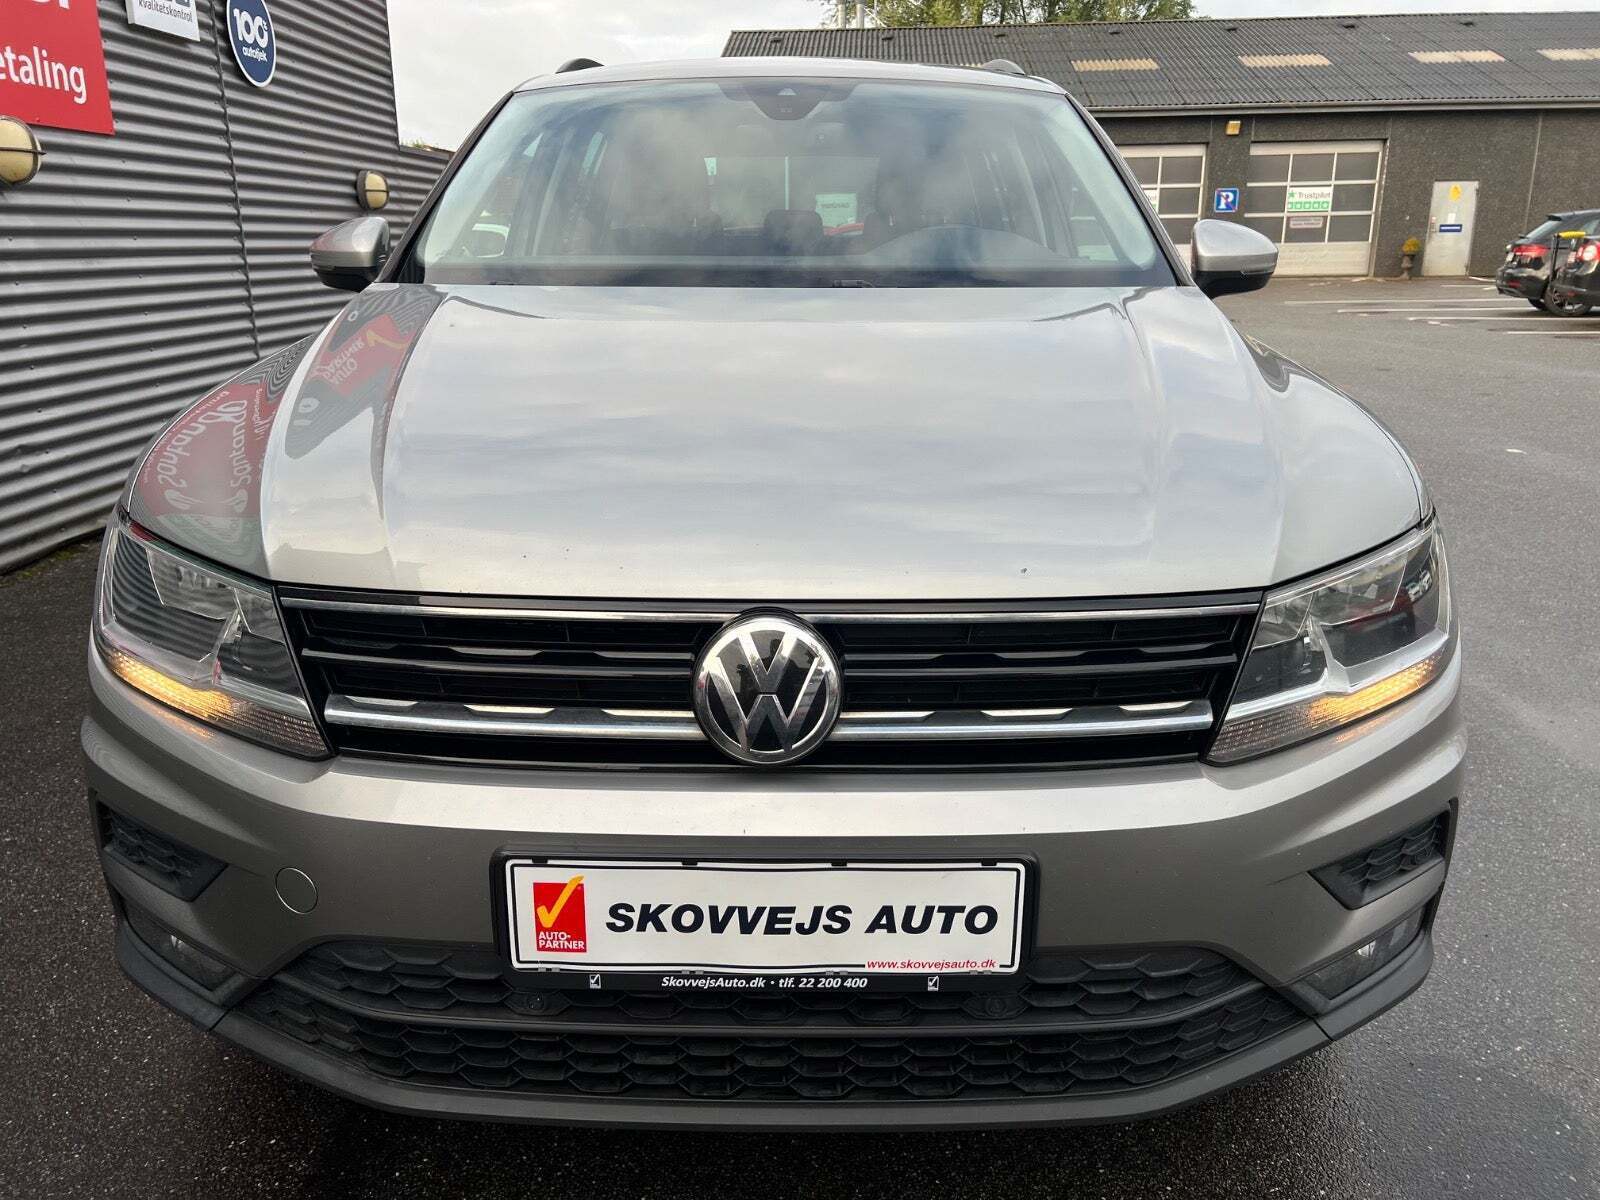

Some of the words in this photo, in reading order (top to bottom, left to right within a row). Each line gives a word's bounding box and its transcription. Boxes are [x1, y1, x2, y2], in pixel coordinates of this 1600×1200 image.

[605, 903, 853, 935] SKOVVEJS
[864, 905, 999, 936] AUTO
[538, 940, 586, 951] PARTNER
[867, 959, 998, 973] www.skovvejsauto.dk
[661, 976, 766, 989] SkovvejsAuto.dk
[778, 977, 796, 988] tlf.
[798, 978, 815, 988] 22
[817, 978, 841, 988] 200
[843, 978, 868, 988] 400
